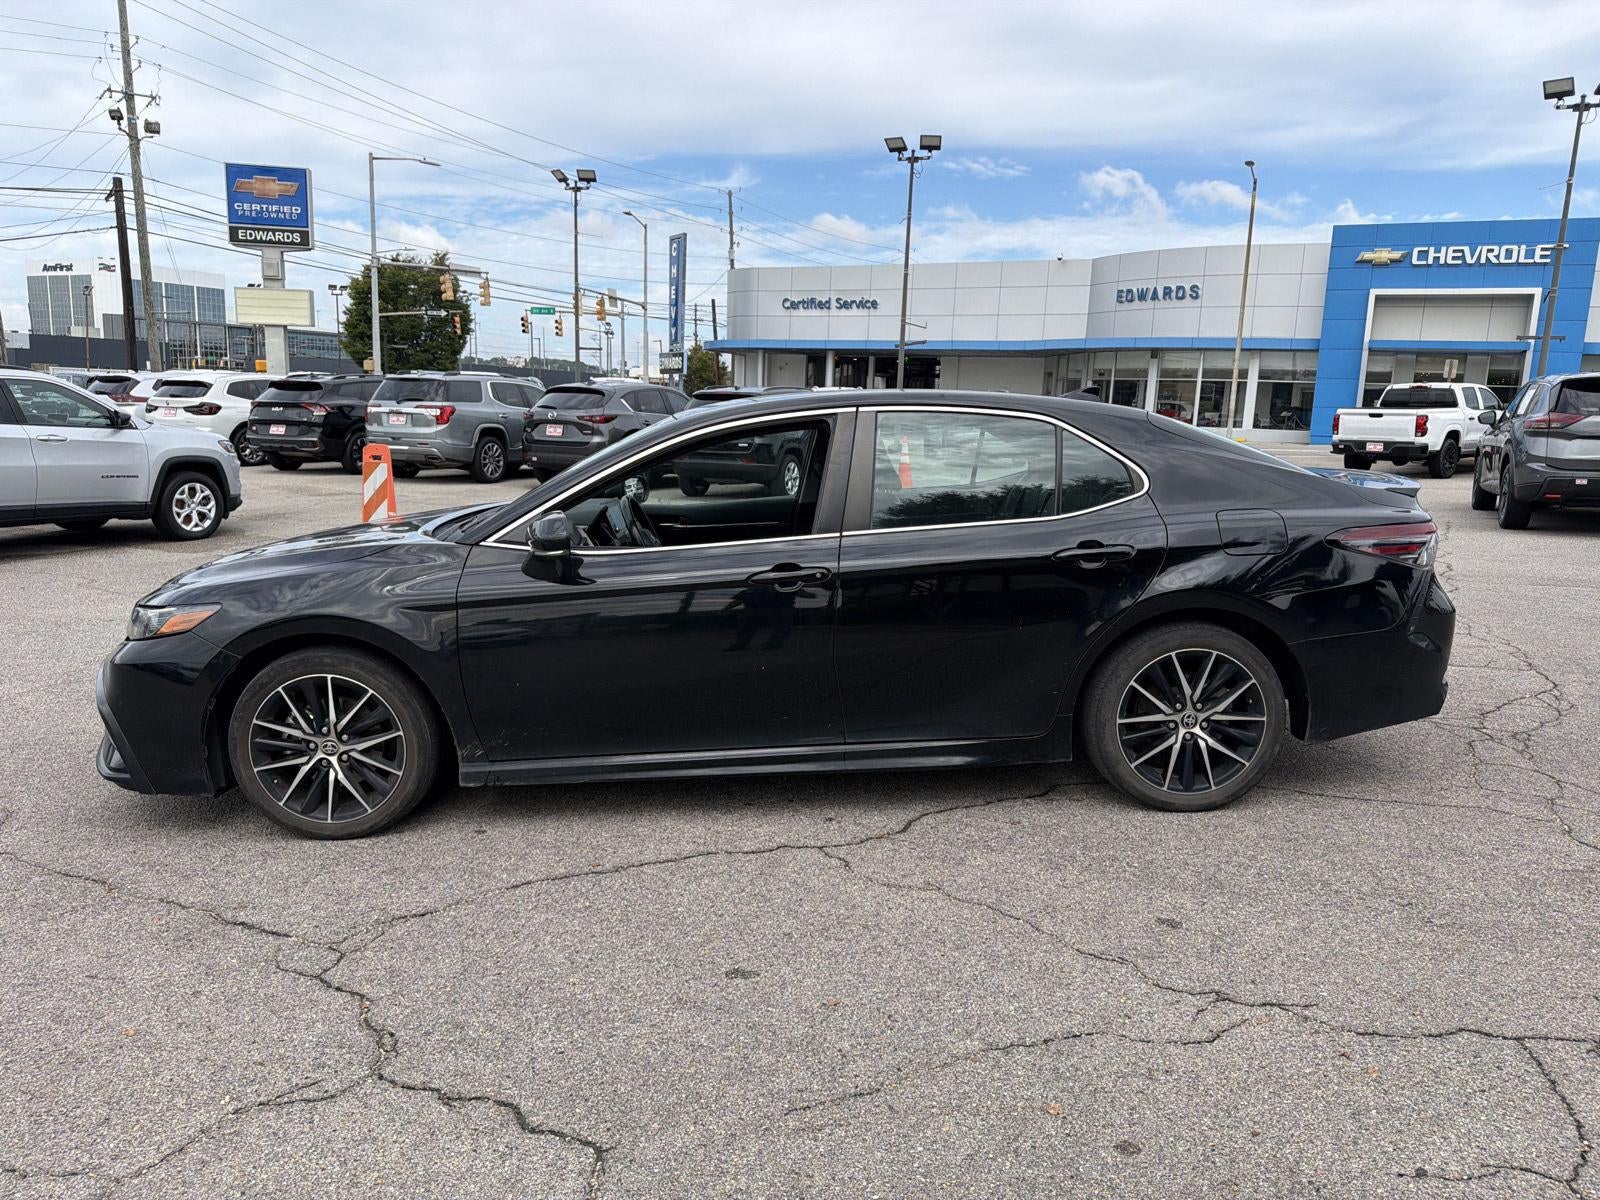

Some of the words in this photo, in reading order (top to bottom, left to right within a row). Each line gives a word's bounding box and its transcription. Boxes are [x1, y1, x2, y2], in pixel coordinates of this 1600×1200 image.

[234, 202, 301, 214] CERTIFIED
[238, 210, 298, 220] PRE-OWNED
[238, 229, 301, 243] EDWARDS
[42, 262, 73, 272] AmFirst
[1116, 284, 1201, 303] EDWARDS
[781, 297, 831, 310] Certified
[835, 297, 878, 310] Service
